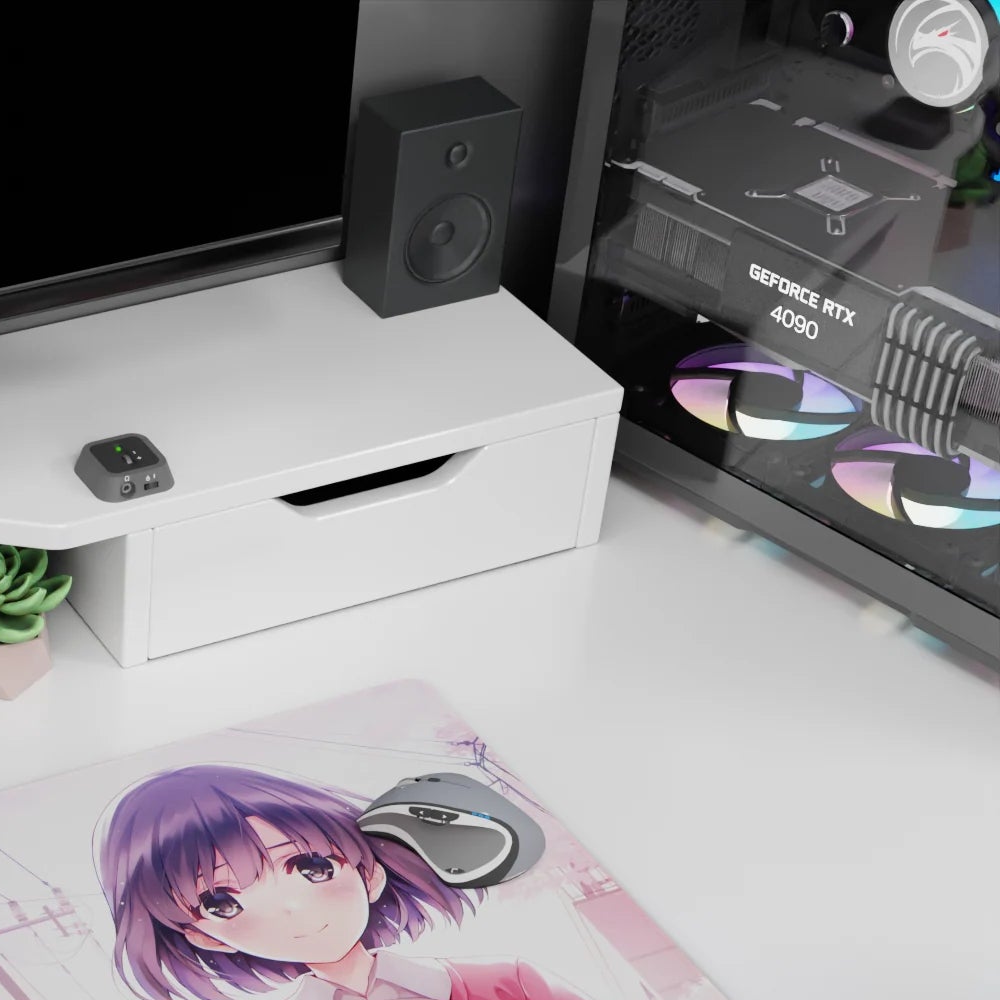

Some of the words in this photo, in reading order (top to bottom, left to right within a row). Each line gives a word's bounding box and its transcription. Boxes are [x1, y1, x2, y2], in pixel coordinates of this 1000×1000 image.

[749, 263, 820, 309] GEFORCE
[822, 298, 856, 327] RTX
[770, 305, 819, 340] 4090
